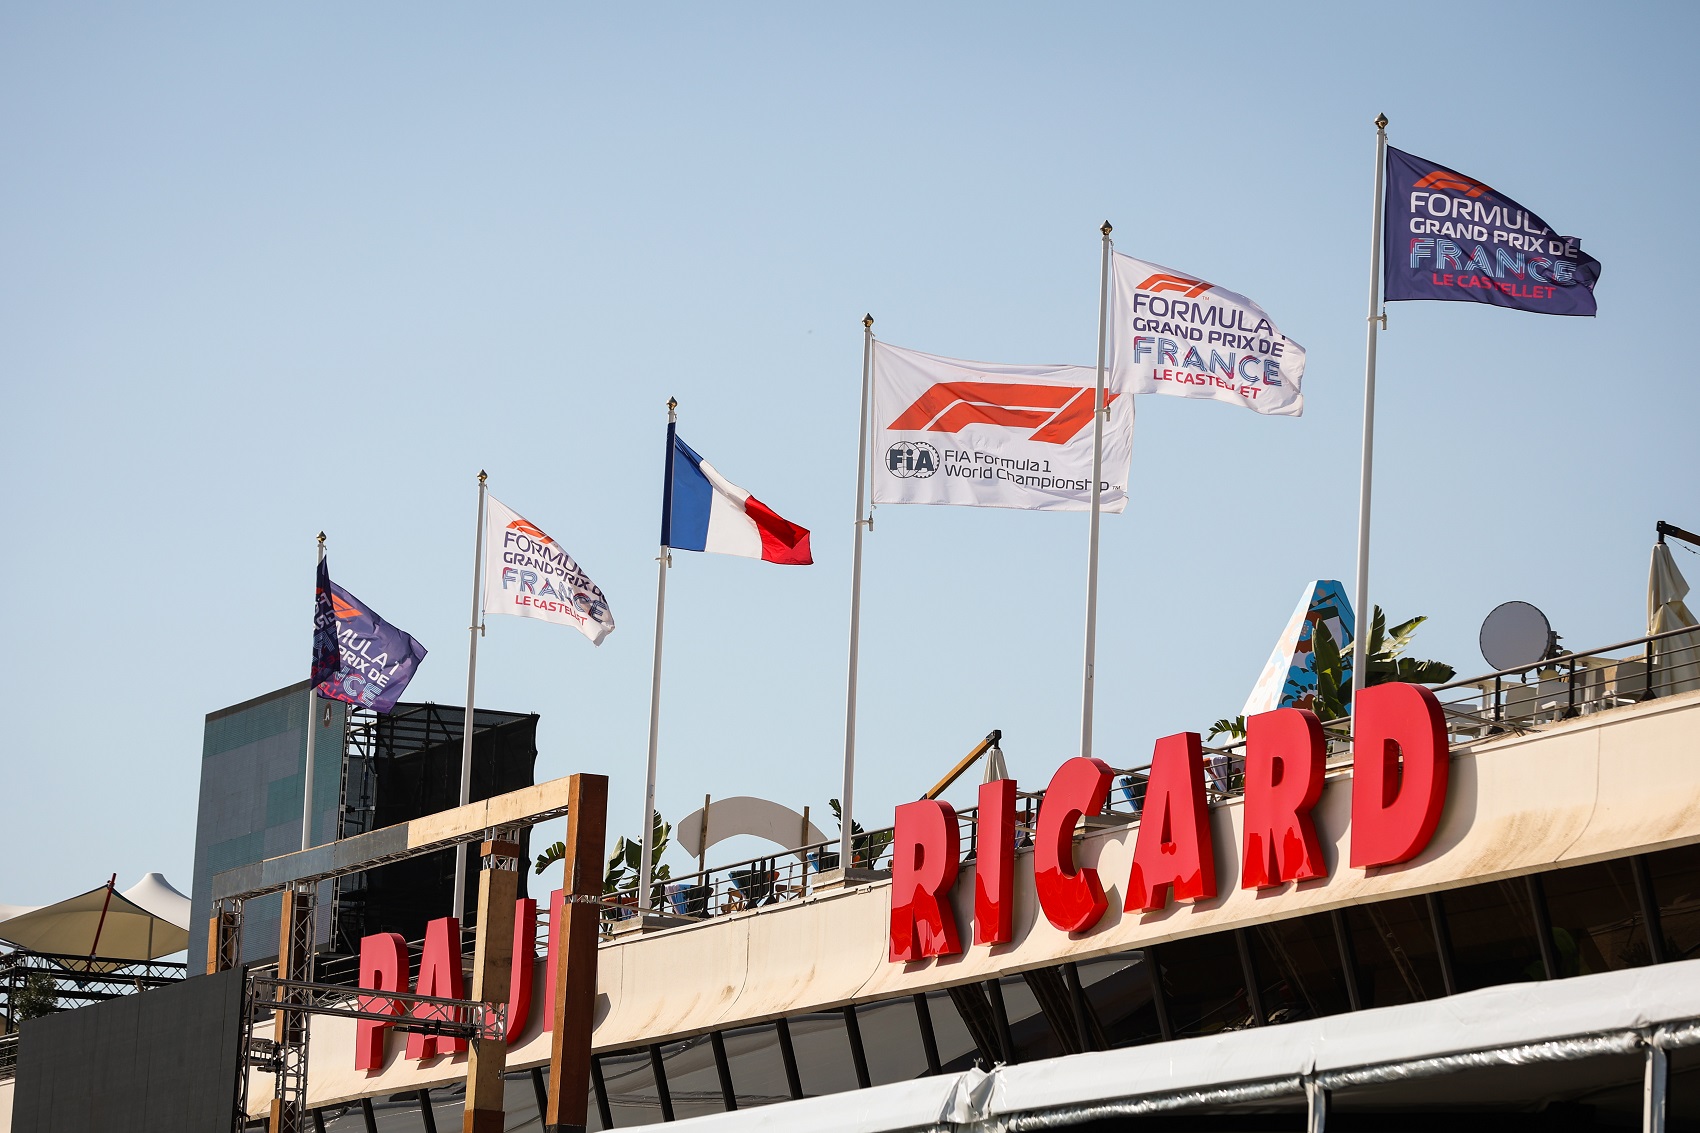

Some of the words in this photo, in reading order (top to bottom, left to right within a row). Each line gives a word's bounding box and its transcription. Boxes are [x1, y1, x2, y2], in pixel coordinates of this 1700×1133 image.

[1409, 217, 1488, 242] GRAND
[1493, 230, 1545, 254] PRIX
[1548, 240, 1578, 259] DE
[1409, 237, 1577, 286] FRANCE
[1432, 273, 1454, 286] LE
[1457, 274, 1557, 299] CASTELLET
[1133, 293, 1274, 337] FORMULA
[1133, 317, 1204, 342] GRAND
[1208, 330, 1255, 352] PRIX
[1258, 338, 1285, 358] DE
[1133, 335, 1283, 387] FRANCE
[1153, 368, 1173, 381] LE
[944, 449, 971, 464] FIA
[974, 450, 1039, 473] Formula
[1042, 460, 1052, 473] 1
[944, 463, 993, 480] World
[996, 468, 1110, 493] Championshp
[503, 551, 554, 575] GRAND
[502, 566, 608, 624] FRANCE
[515, 594, 531, 606] LE
[368, 669, 389, 688] DE
[889, 682, 1450, 963] RICARD
